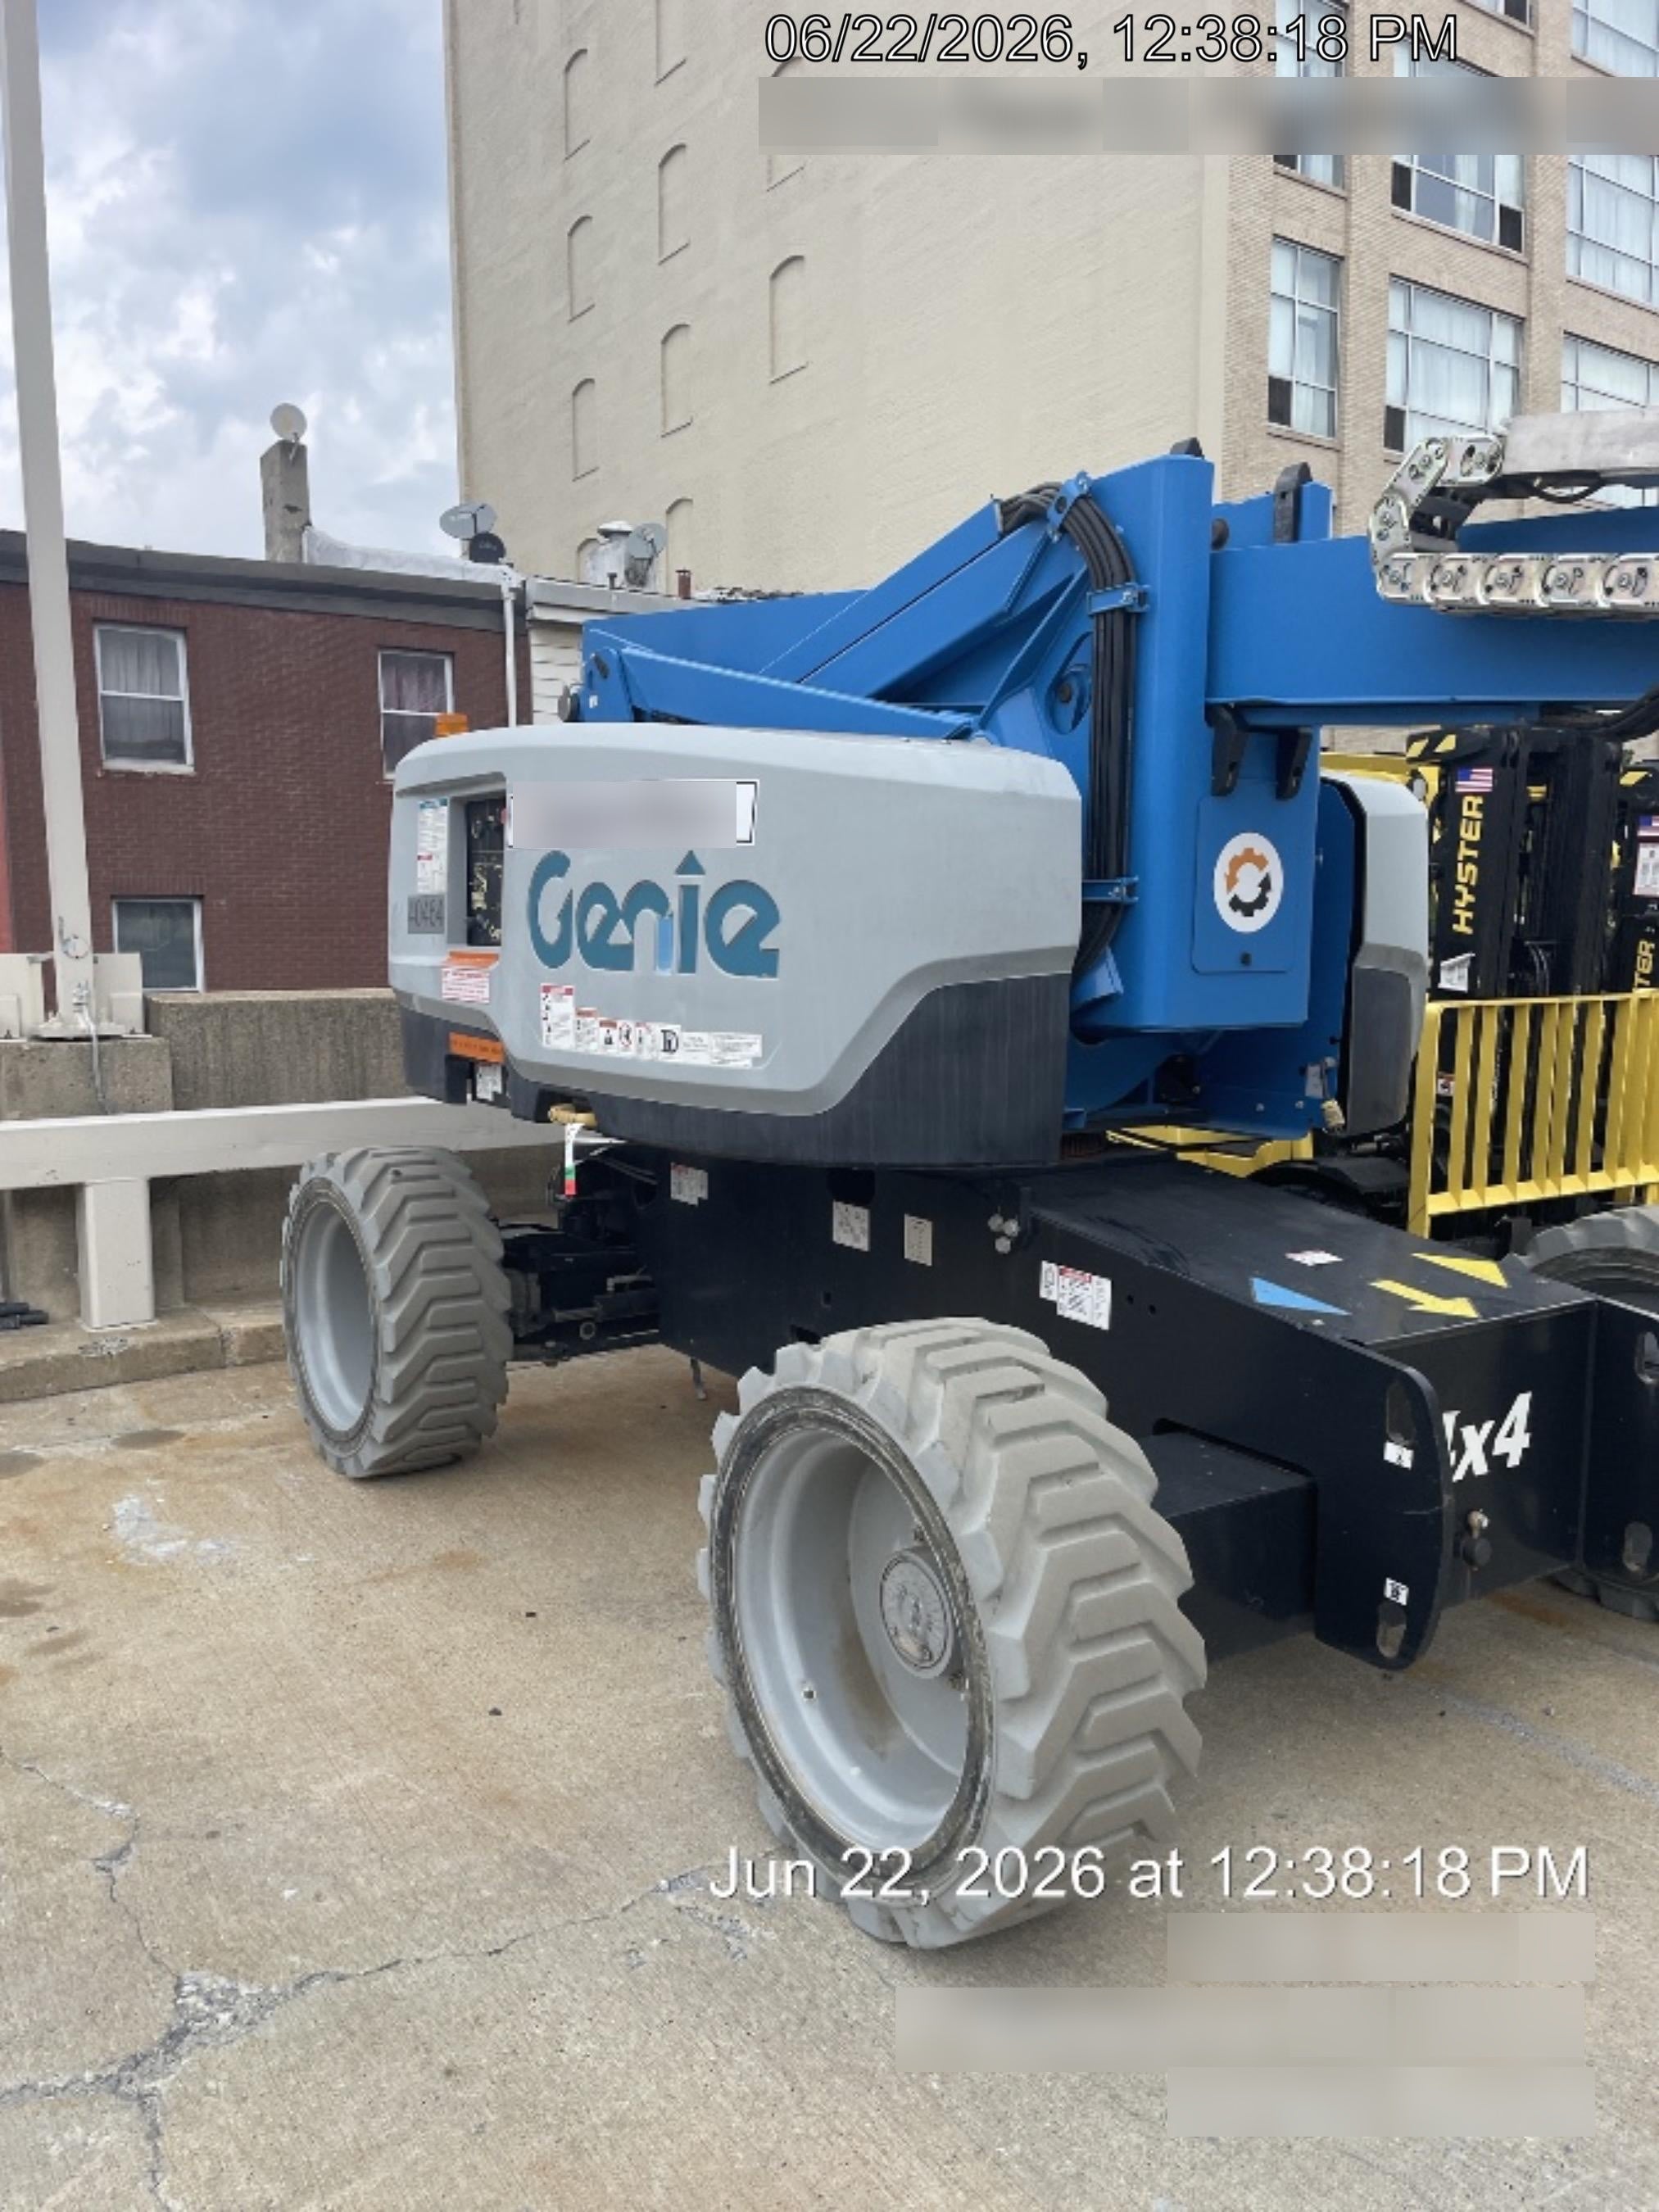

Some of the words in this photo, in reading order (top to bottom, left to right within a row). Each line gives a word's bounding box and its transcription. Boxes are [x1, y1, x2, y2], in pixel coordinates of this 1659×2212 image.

[528, 850, 779, 978] Genie
[1453, 796, 1483, 934] HYSTER
[1633, 940, 1655, 989] TER
